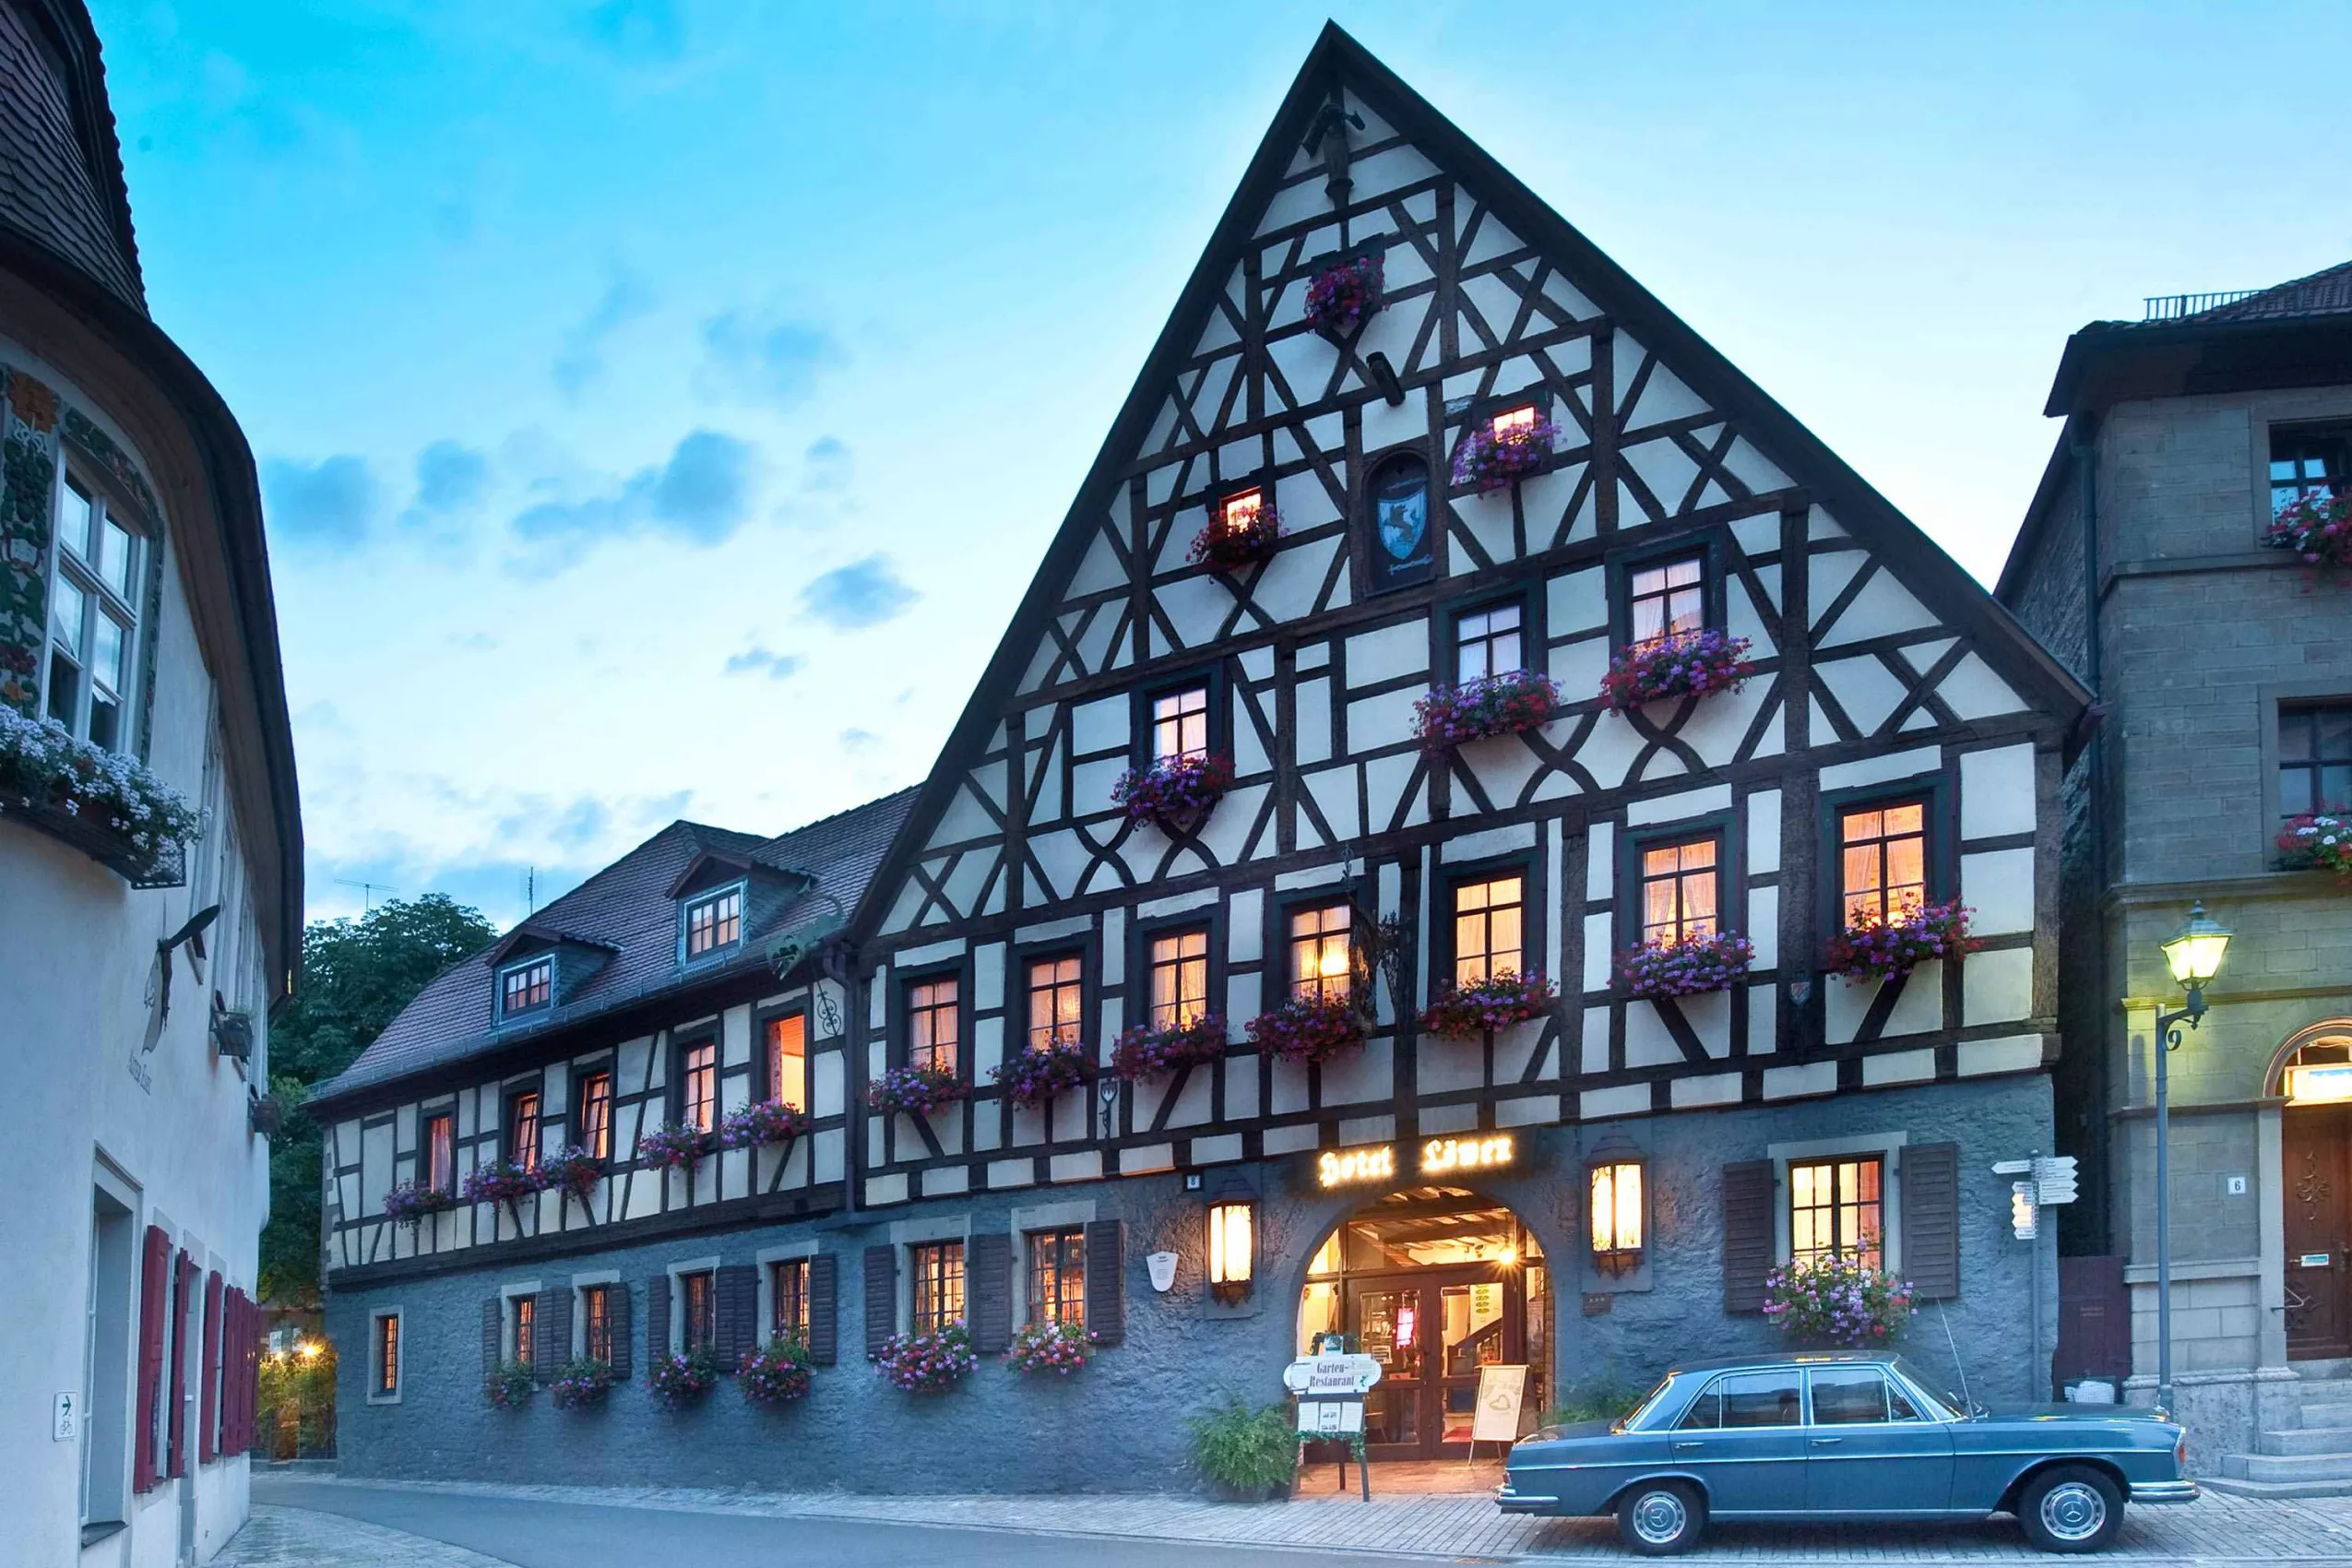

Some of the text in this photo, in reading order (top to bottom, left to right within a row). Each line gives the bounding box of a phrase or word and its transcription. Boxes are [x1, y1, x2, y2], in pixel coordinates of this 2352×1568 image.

[1319, 1146, 1393, 1187] Hotel
[2234, 1180, 2241, 1191] 6
[1316, 1362, 1348, 1374] Garten-
[1309, 1375, 1355, 1387] Restaurant
